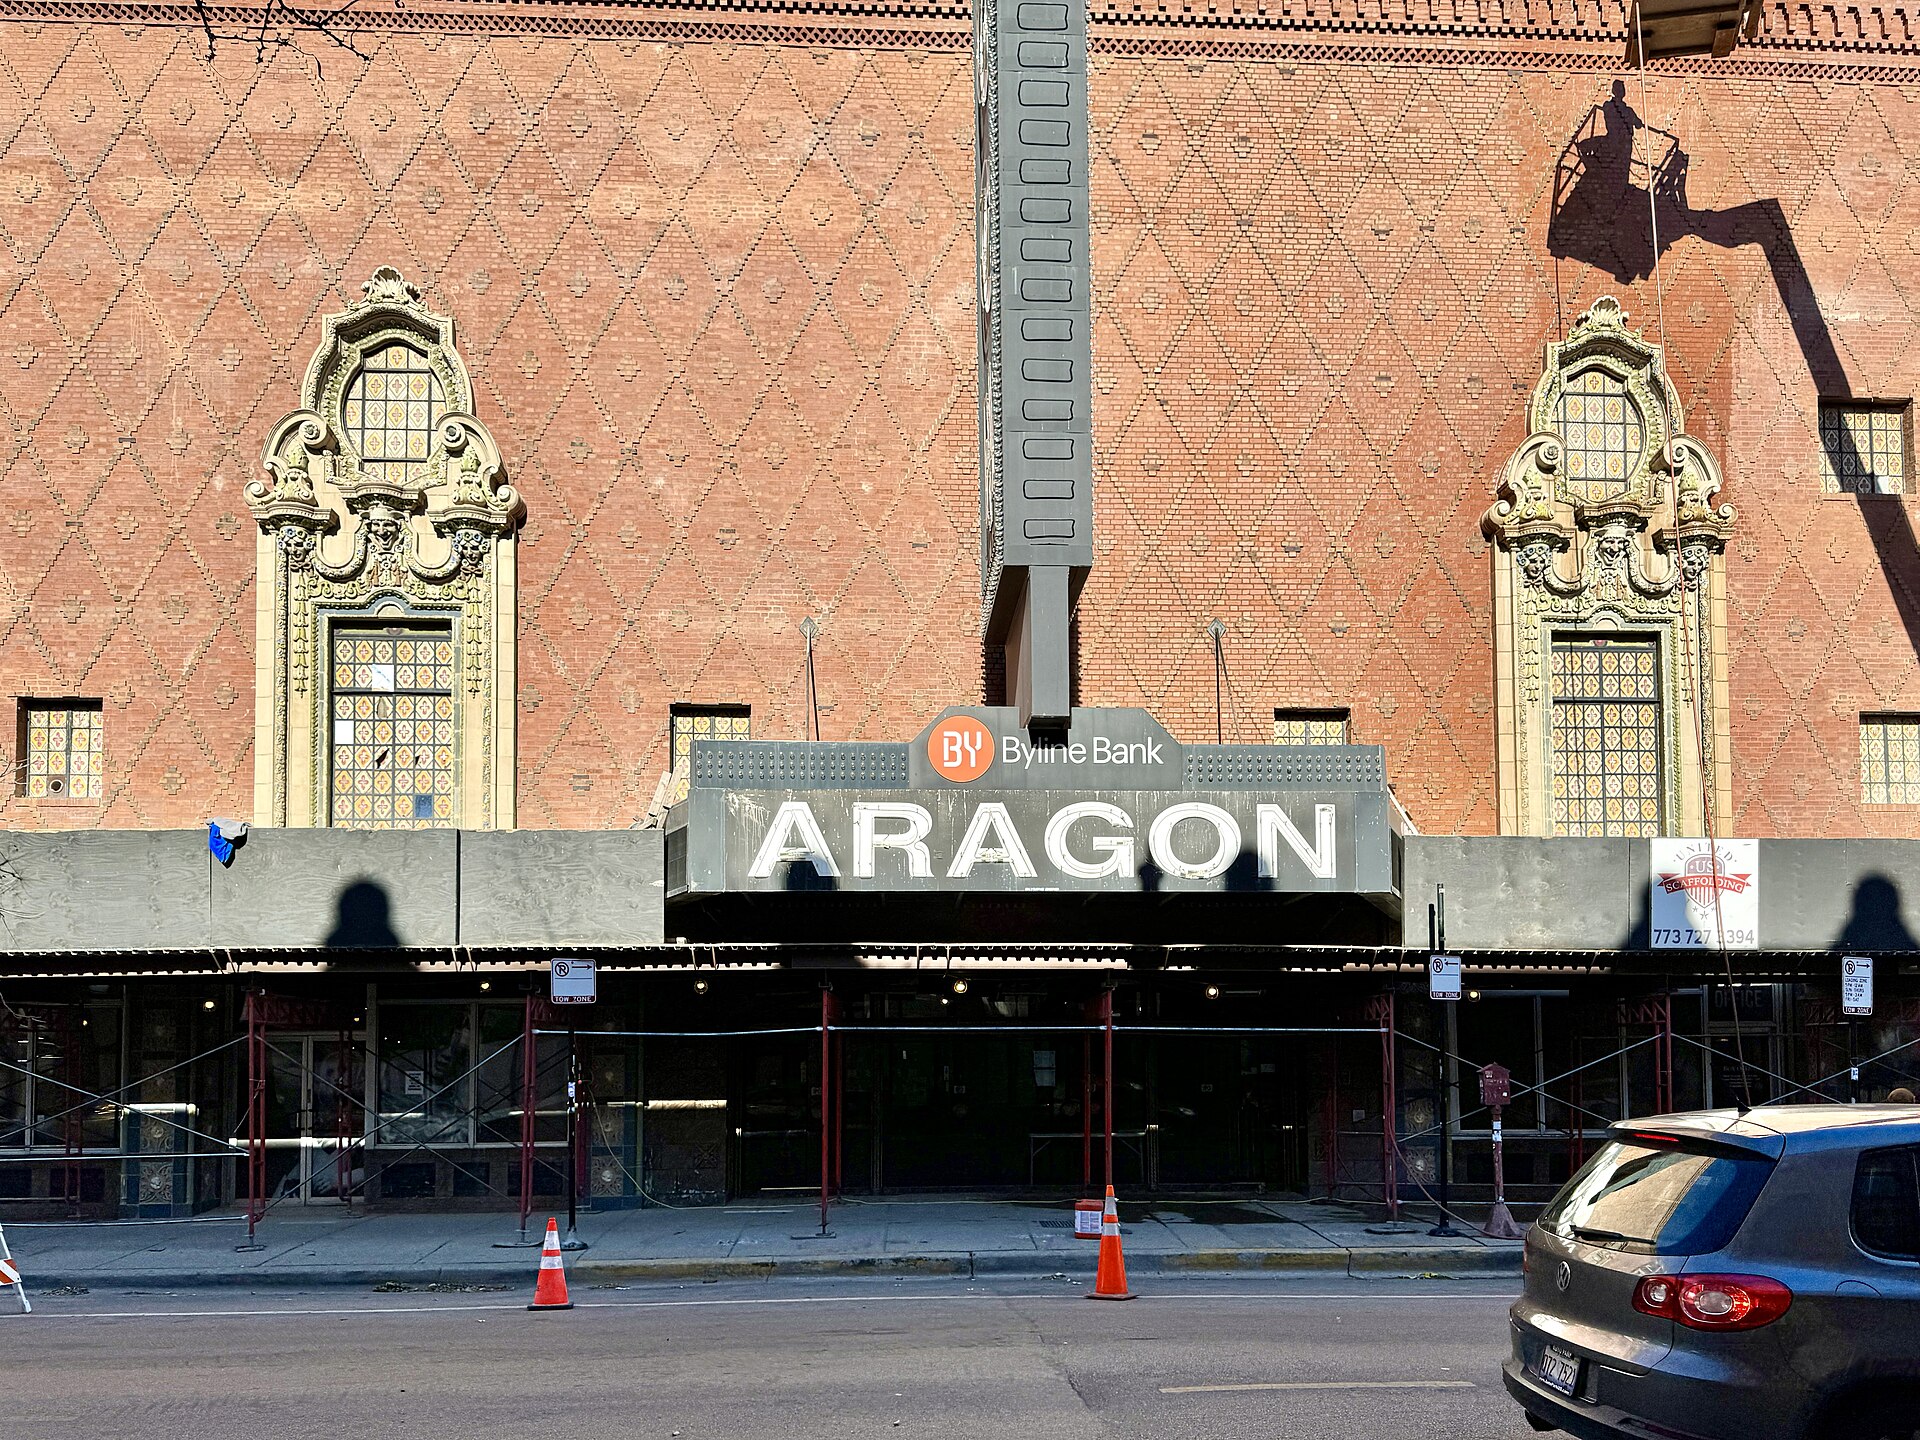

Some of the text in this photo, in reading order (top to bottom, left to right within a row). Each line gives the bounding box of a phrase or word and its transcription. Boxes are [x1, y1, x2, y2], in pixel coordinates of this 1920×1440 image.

[943, 730, 1164, 770] BY Byline Bank
[747, 801, 1337, 879] ARAGON
[1675, 842, 1734, 862] UNITED
[1695, 860, 1716, 873] US
[1665, 877, 1744, 893] SCAFFOLDING
[1653, 929, 1755, 945] 773 727 394
